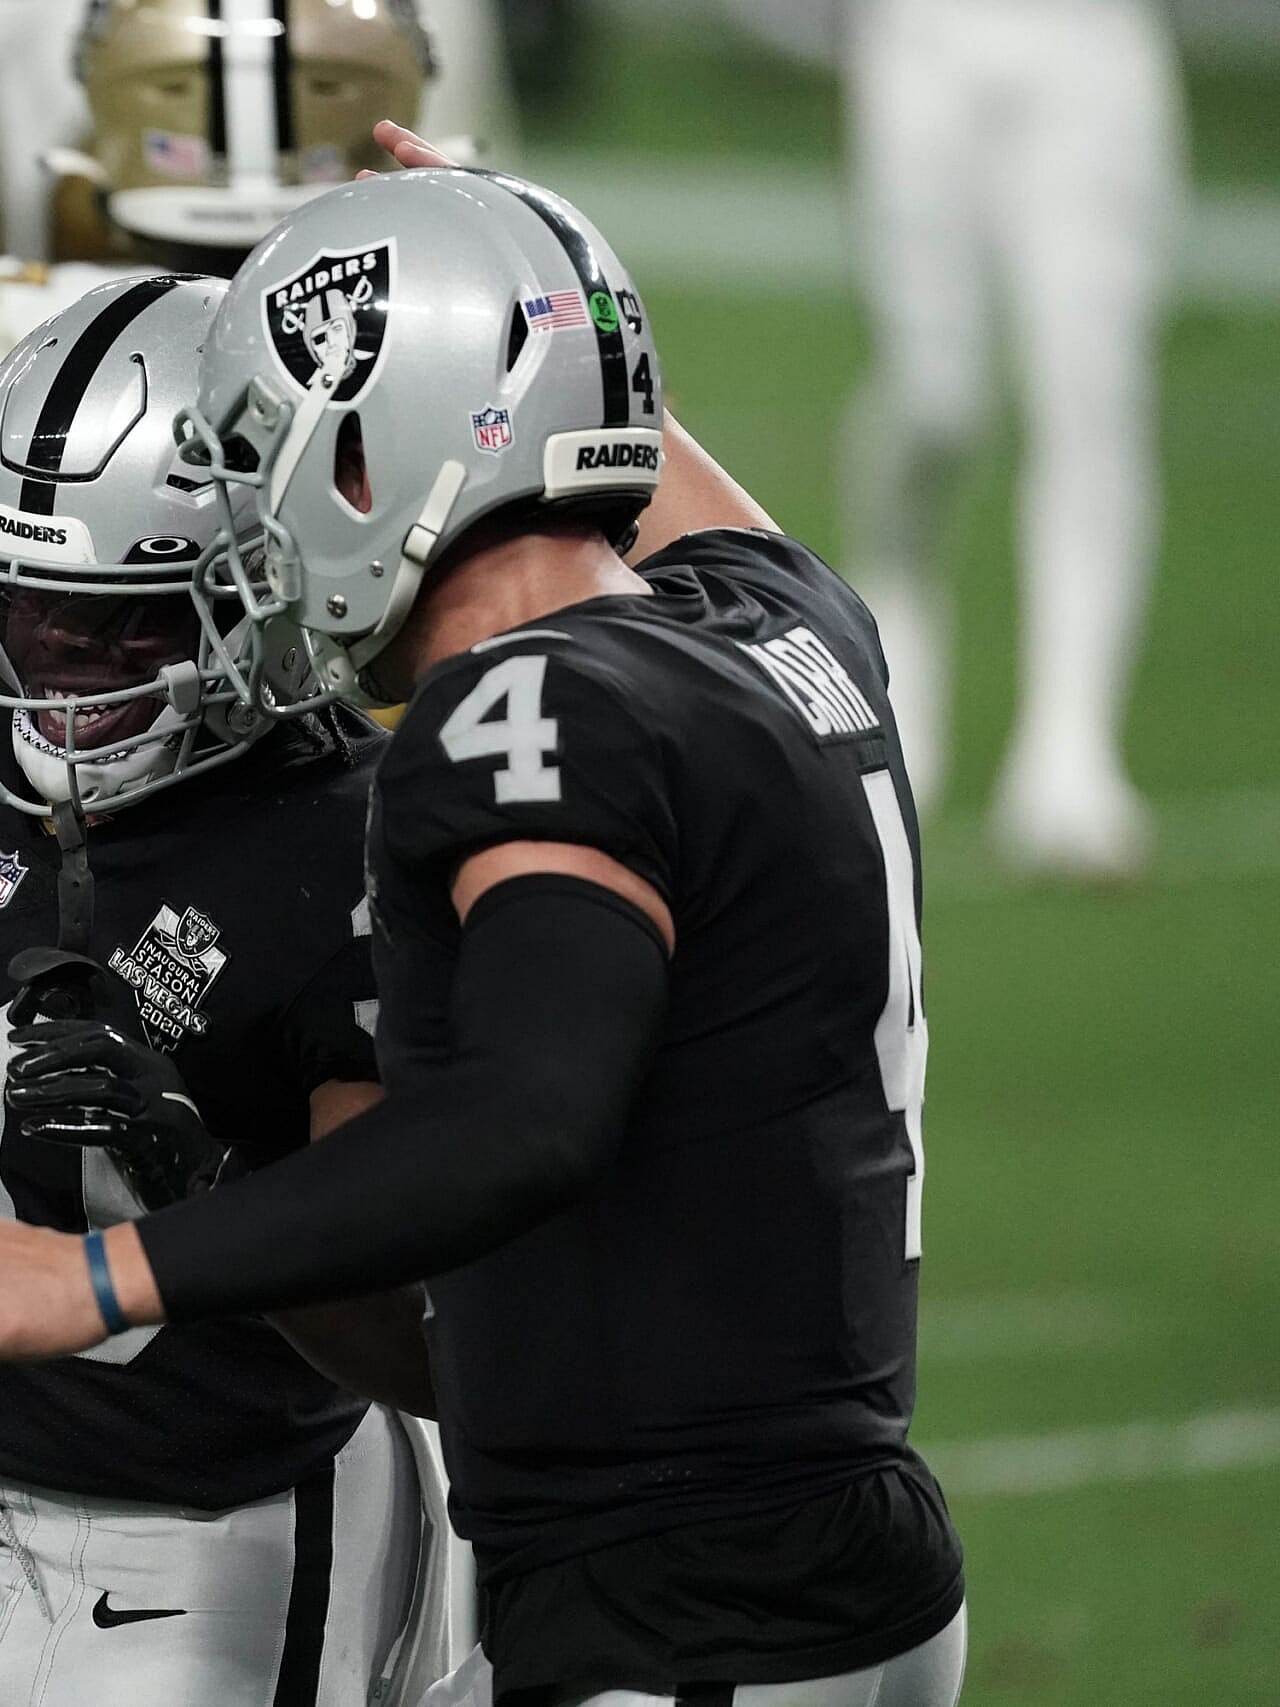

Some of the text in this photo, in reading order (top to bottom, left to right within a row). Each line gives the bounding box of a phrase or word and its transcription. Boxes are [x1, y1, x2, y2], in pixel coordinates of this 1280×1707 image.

[275, 252, 377, 308] RAIDERS
[632, 352, 655, 415] 4
[479, 425, 510, 448] NFL
[576, 443, 659, 471] RAIDERS
[438, 654, 562, 805] 4
[187, 910, 217, 936] RAIDERS
[108, 947, 207, 1034] LAS VEGAS
[135, 949, 196, 1004] SEASON
[142, 940, 200, 993] INAUGURAL
[139, 1002, 184, 1039] 2020
